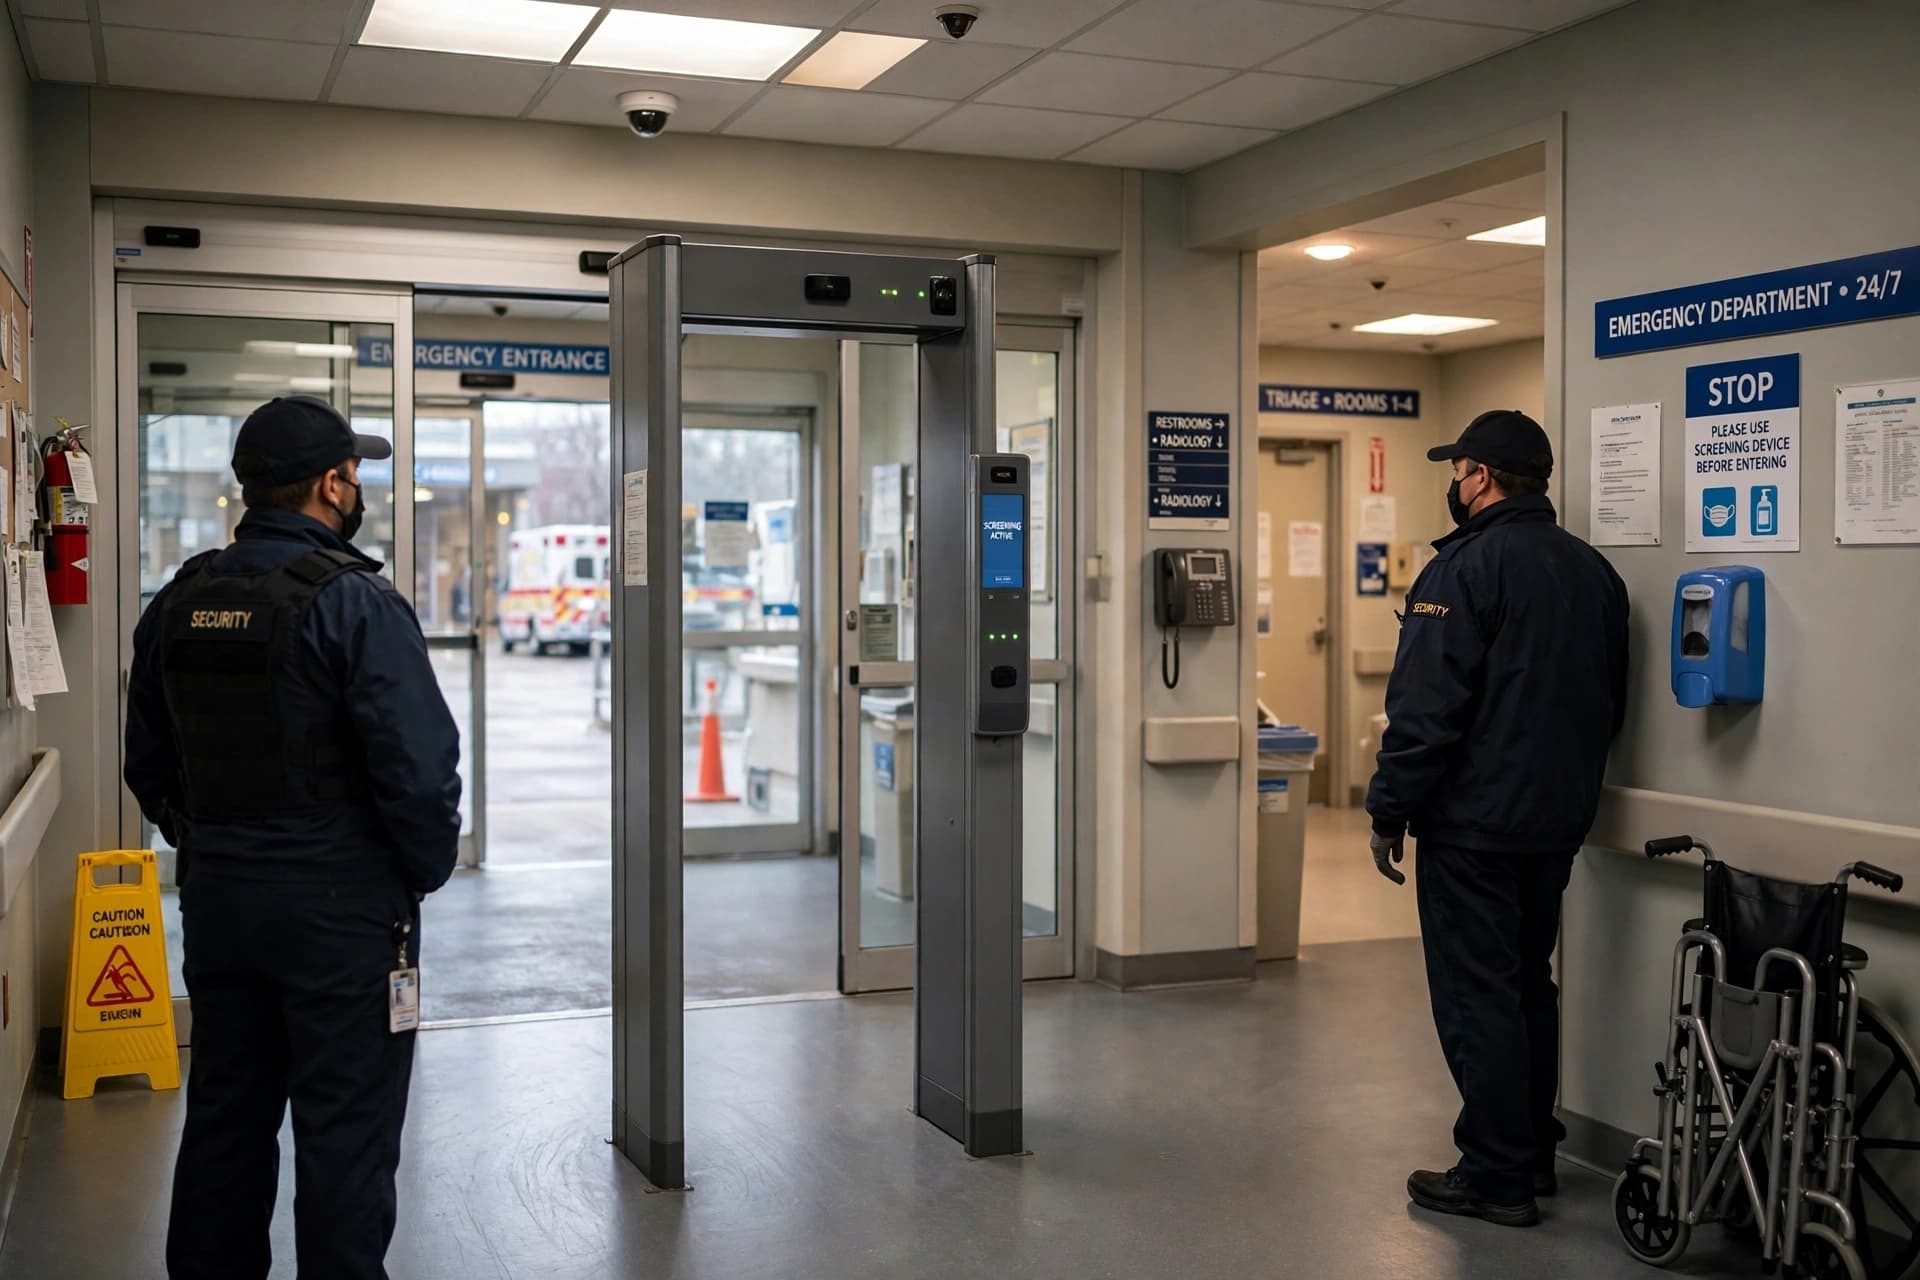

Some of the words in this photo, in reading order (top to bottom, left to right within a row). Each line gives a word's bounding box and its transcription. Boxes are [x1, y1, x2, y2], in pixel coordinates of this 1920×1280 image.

[1608, 302, 1706, 338] EMERGENCY
[1710, 281, 1833, 323] DEPARTMENT
[1856, 269, 1902, 301] 24/7
[371, 342, 495, 366] ERGENCY
[502, 349, 606, 371] ENTRANCE
[1708, 371, 1774, 407] STOP
[1265, 389, 1319, 409] TRIAGE
[1334, 391, 1388, 412] ROOMS
[1155, 416, 1213, 430] RESTROOMS
[1711, 422, 1747, 438] PLEASE
[1750, 420, 1770, 434] USE
[1160, 434, 1213, 448] RADIOLOGY
[1694, 439, 1750, 456] SCREENING
[1752, 436, 1790, 452] DEVICE
[1696, 458, 1734, 473] BEFORE
[1736, 454, 1787, 471] ENTERING
[1160, 493, 1213, 507] RADIOLOGY
[191, 610, 253, 629] SECURITY
[92, 907, 145, 923] CAUTION
